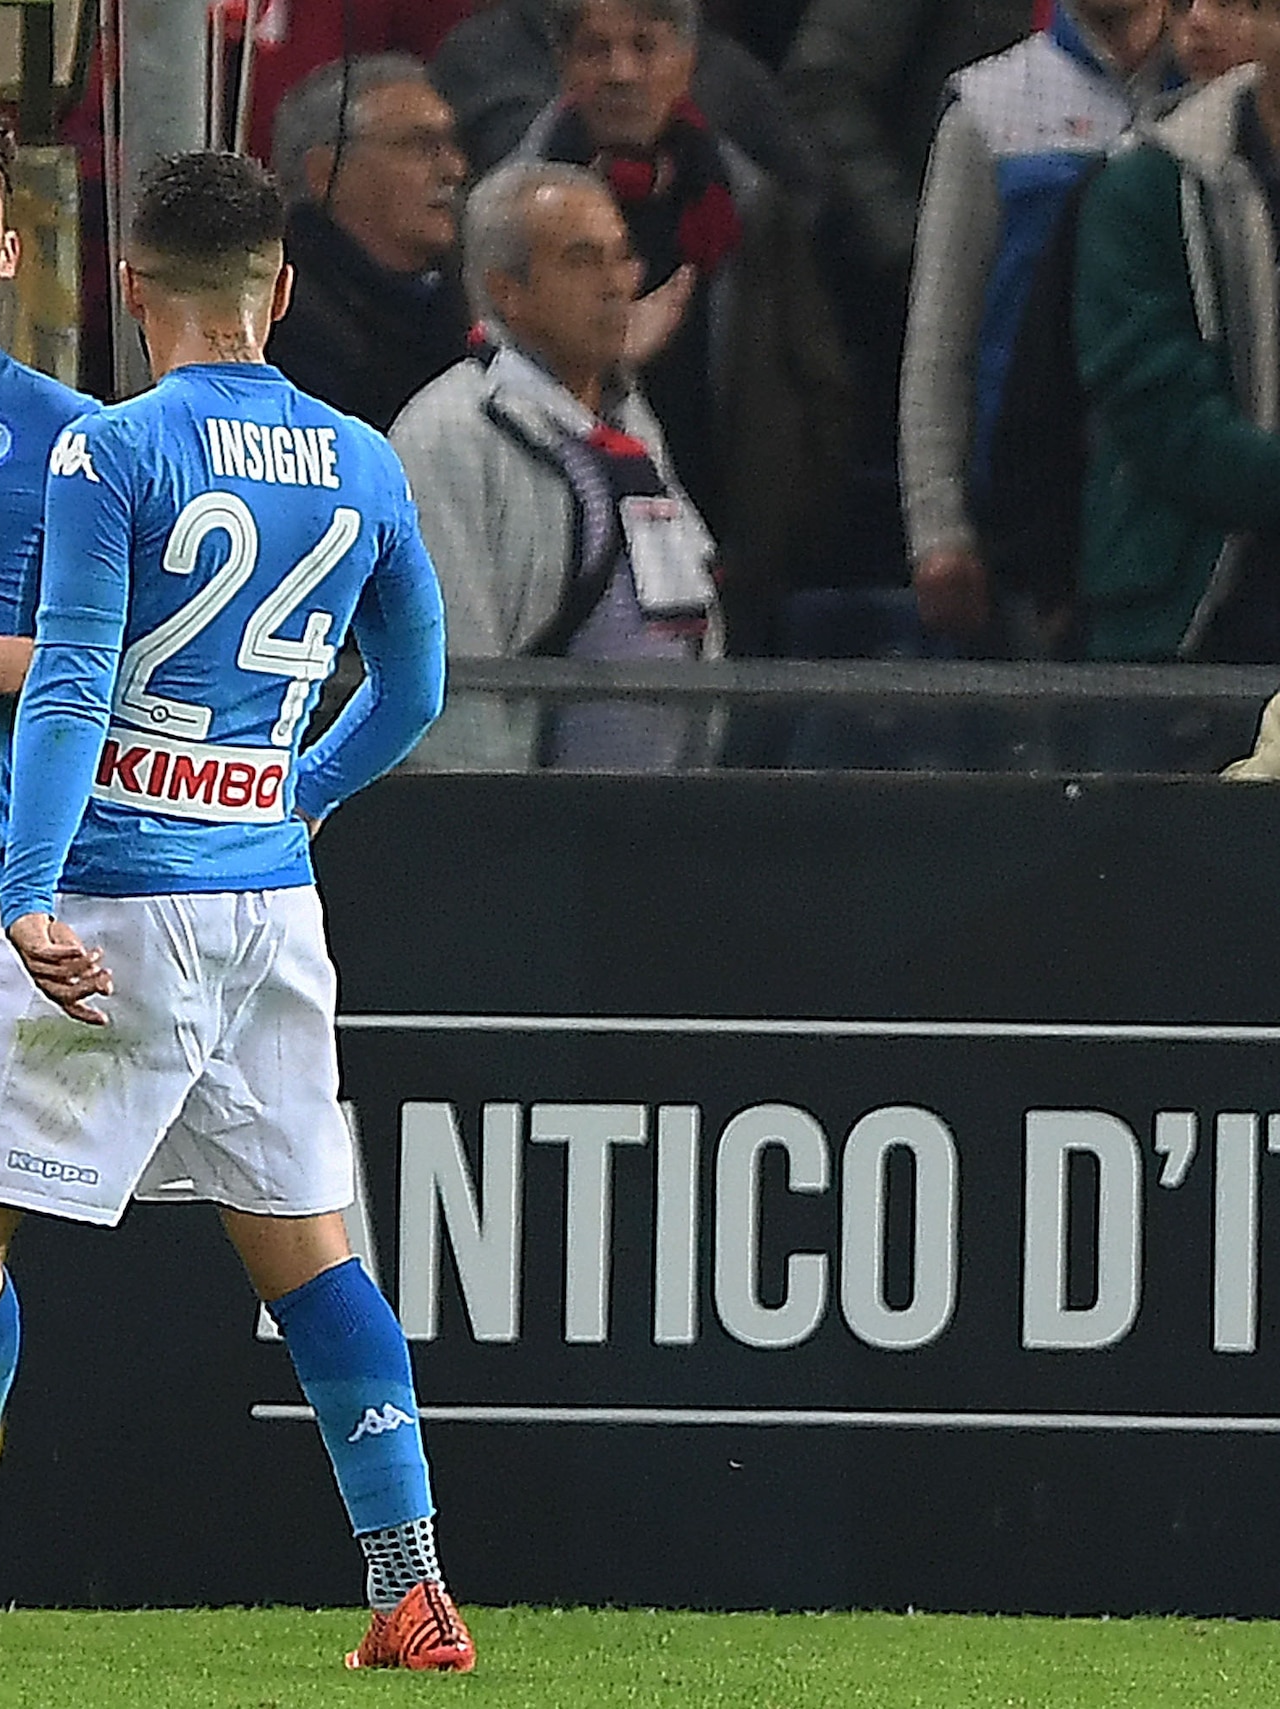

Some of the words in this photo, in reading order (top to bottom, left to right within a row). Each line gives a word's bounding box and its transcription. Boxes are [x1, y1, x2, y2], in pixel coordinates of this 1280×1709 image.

[206, 417, 340, 490] INSIGNE
[113, 491, 361, 747] 24
[95, 741, 282, 809] KIMBO
[7, 1149, 99, 1186] Kappa
[256, 1100, 959, 1350] NTICO
[1023, 1110, 1280, 1353] D'I
